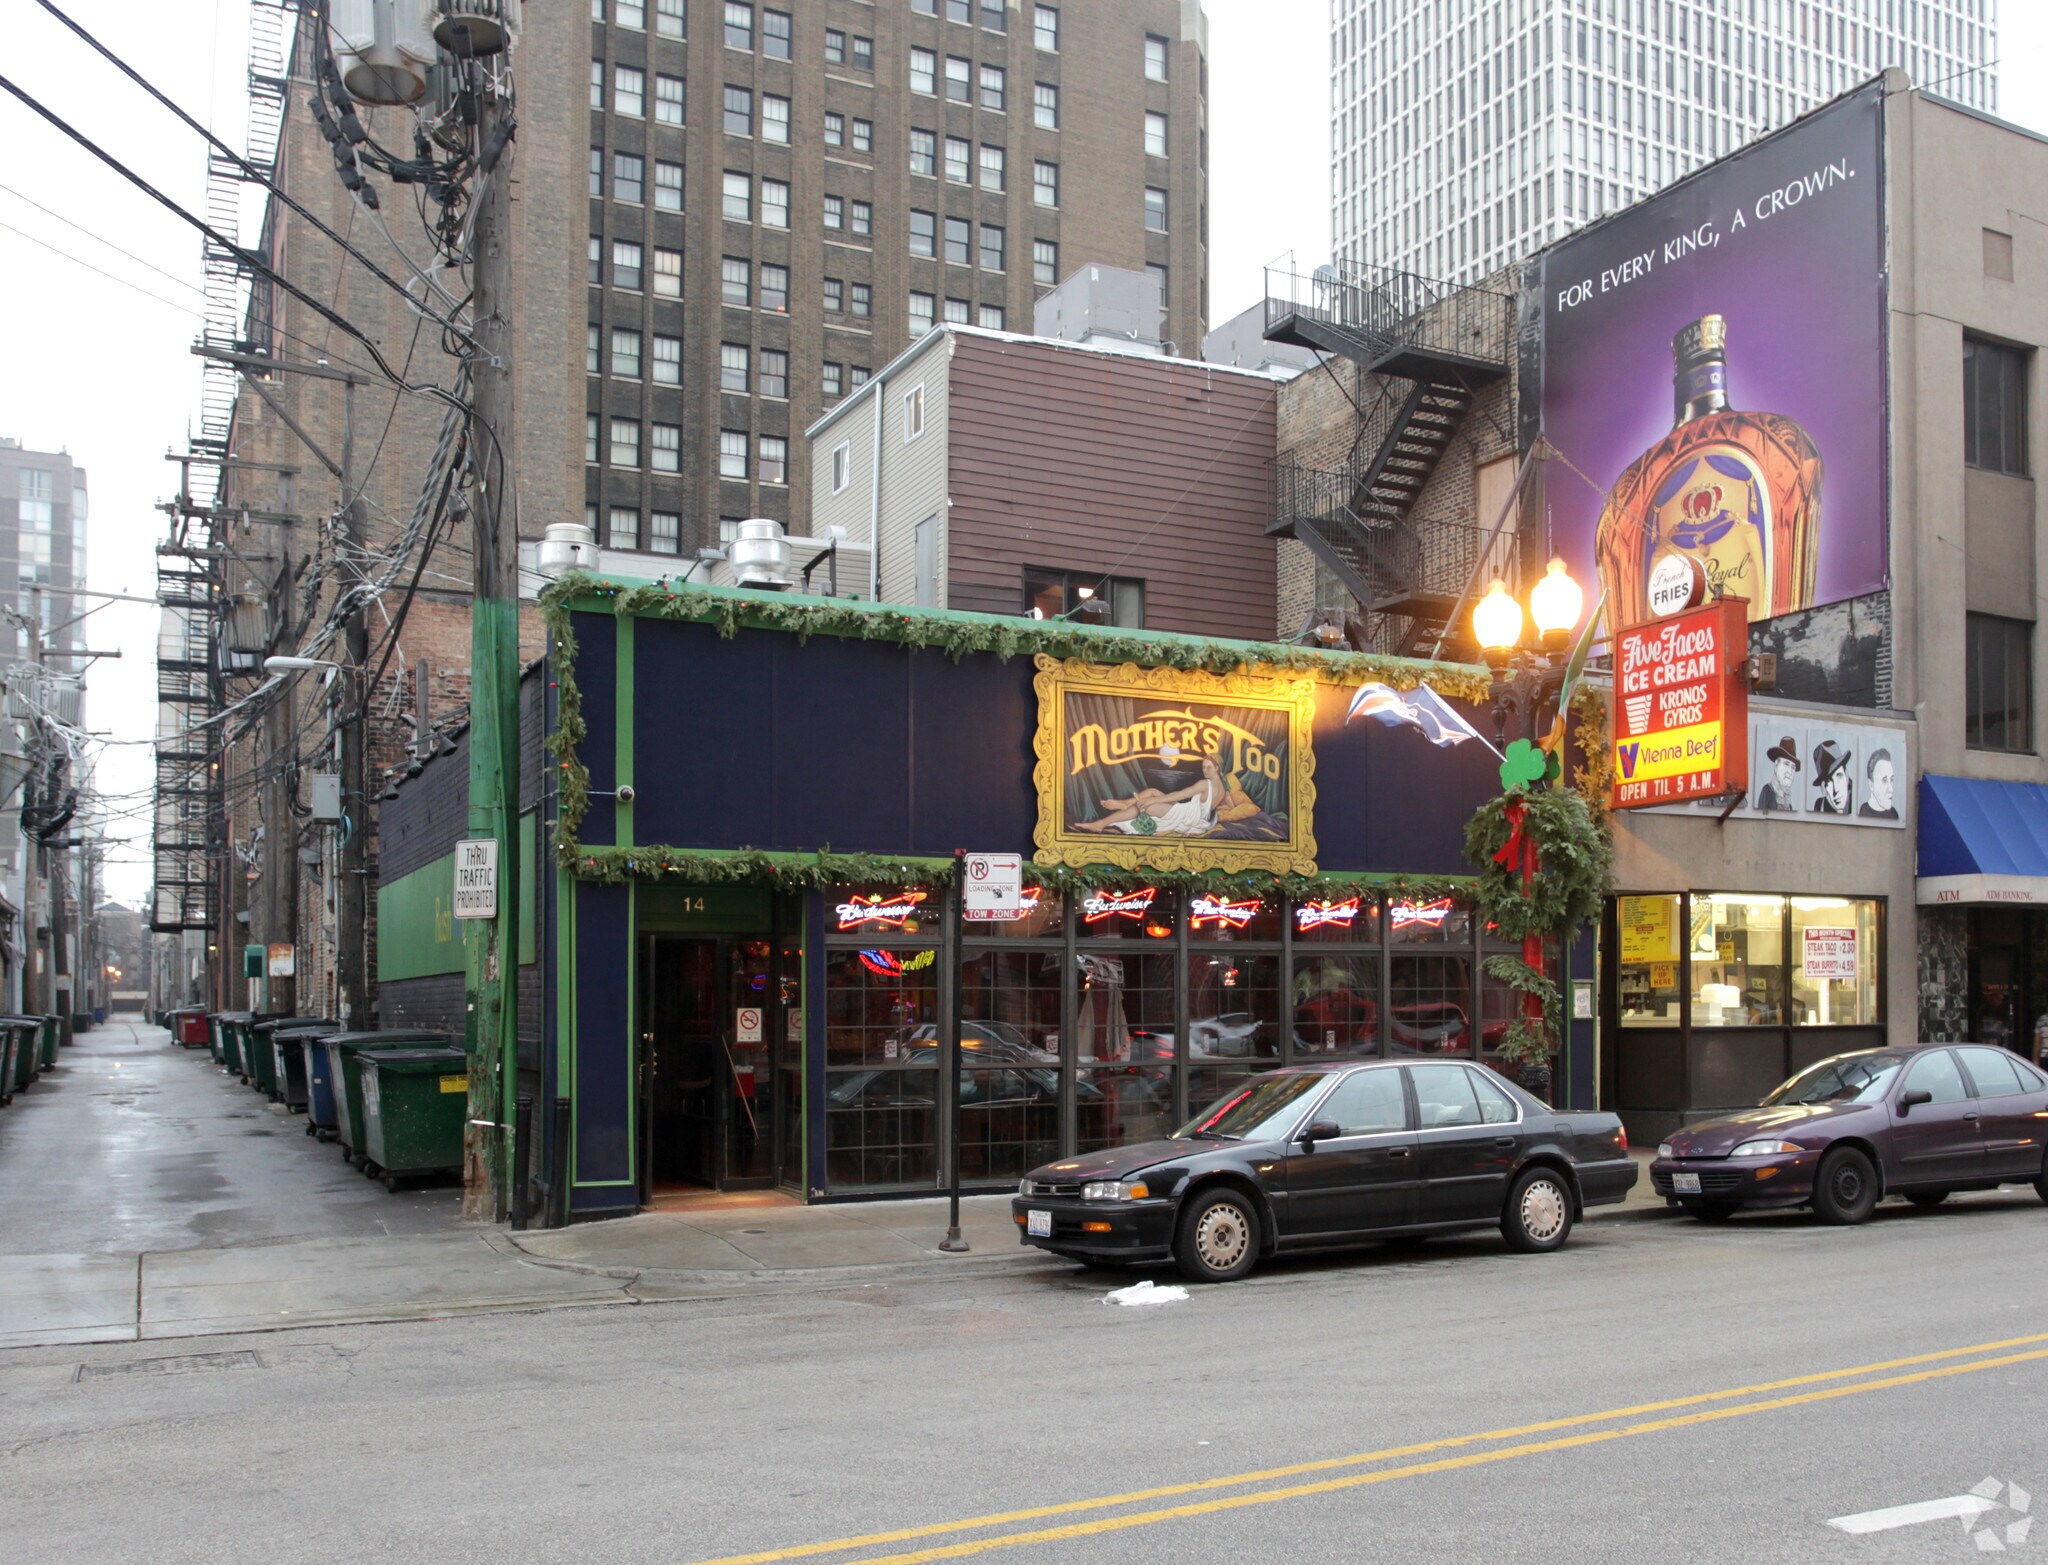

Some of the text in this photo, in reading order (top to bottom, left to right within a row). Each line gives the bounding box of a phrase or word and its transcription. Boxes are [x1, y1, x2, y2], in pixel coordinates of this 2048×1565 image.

[1558, 158, 1855, 312] FOR EVERY KING, A CROWN.
[1653, 563, 1686, 588] French
[1654, 583, 1689, 606] FRIES
[1622, 623, 1715, 673] Five Faces
[1623, 653, 1715, 693] ICE CREAM
[1659, 684, 1707, 711] KRONOS
[1664, 704, 1703, 728] GYROS
[1641, 745, 1682, 765] Vienna
[1686, 734, 1718, 760] Beef
[1620, 771, 1715, 802] OPEN TIL 5 A.M.
[466, 847, 488, 866] THRU
[460, 868, 492, 887] TRAFFIC
[457, 889, 494, 909] PROHIBITED
[683, 896, 705, 912] 14
[1937, 890, 1960, 902] ATM
[1985, 890, 2033, 901] ATM BANKING
[969, 909, 1016, 919] TOW ZONE
[1084, 898, 1152, 915] Budweiser
[1807, 942, 1824, 952] STEAK
[1825, 942, 1837, 952] TACO
[1653, 964, 1670, 972] PICK
[1806, 960, 1821, 970] STEAK
[1653, 978, 1672, 986] HERE
